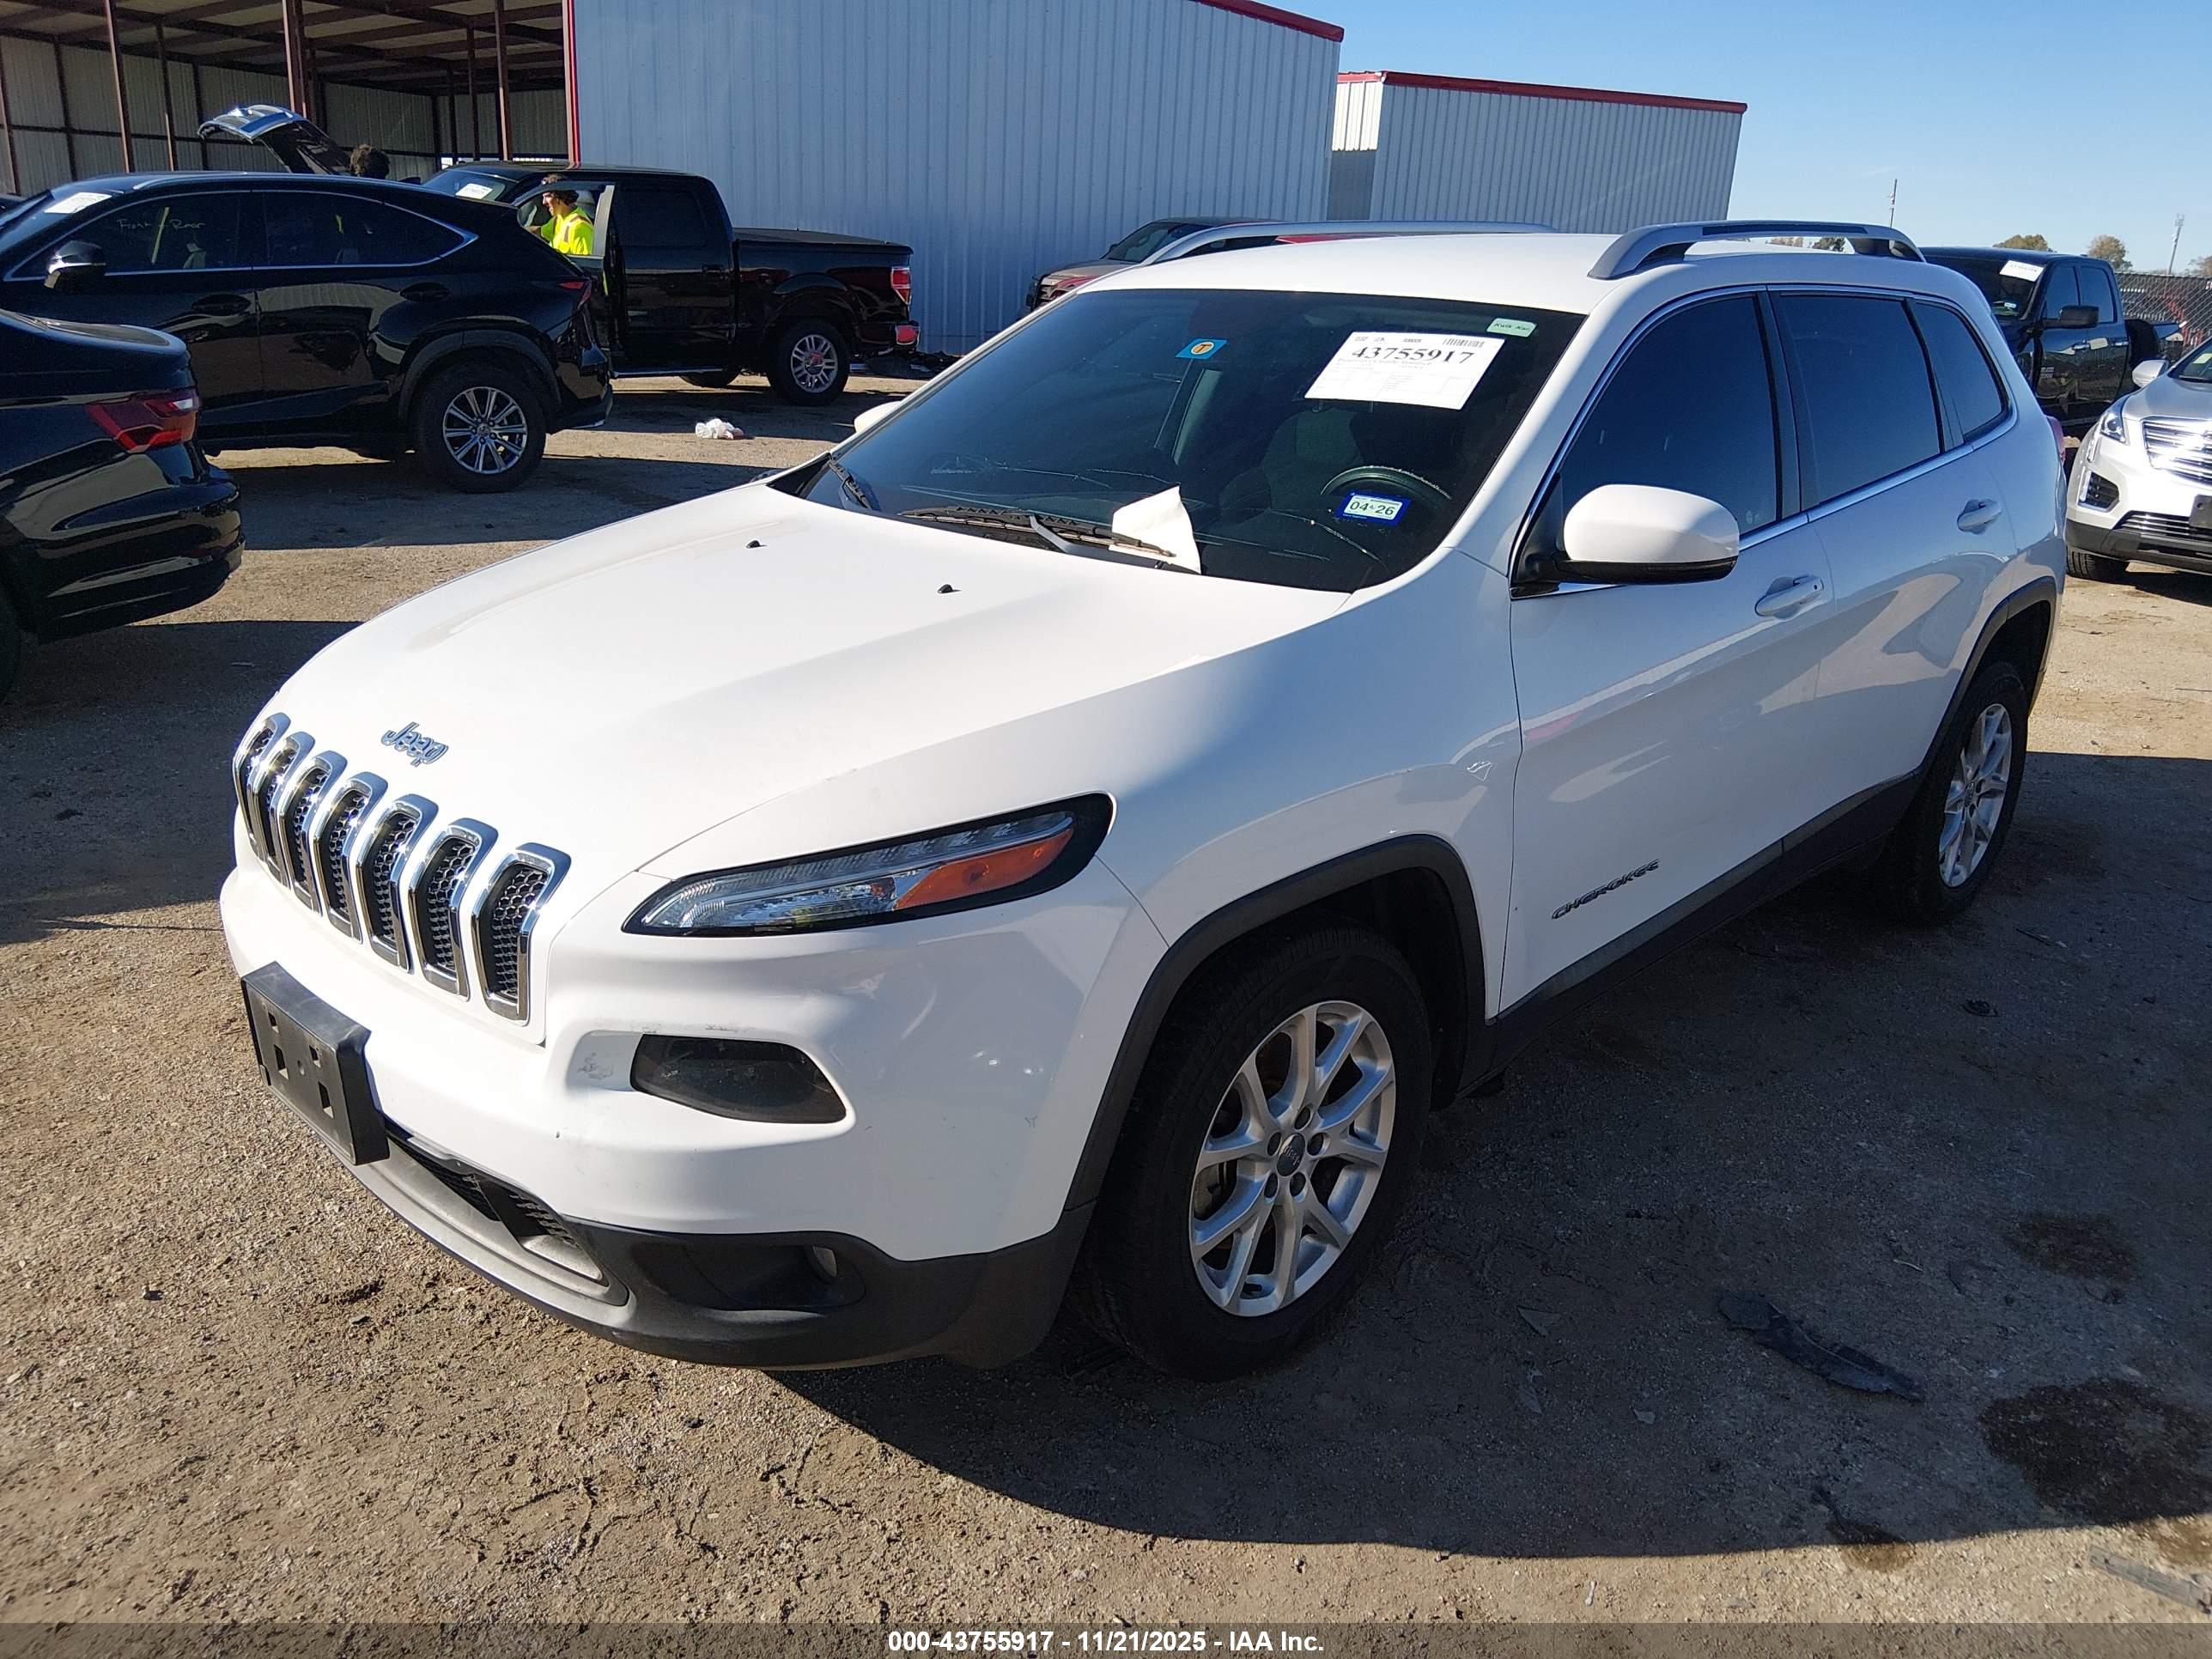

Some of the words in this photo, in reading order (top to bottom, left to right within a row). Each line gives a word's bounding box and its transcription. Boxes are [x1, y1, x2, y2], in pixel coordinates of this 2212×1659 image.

[1352, 345, 1475, 364] 43755917
[380, 722, 449, 768] Jeep
[1552, 858, 1660, 920] CHEROKEE
